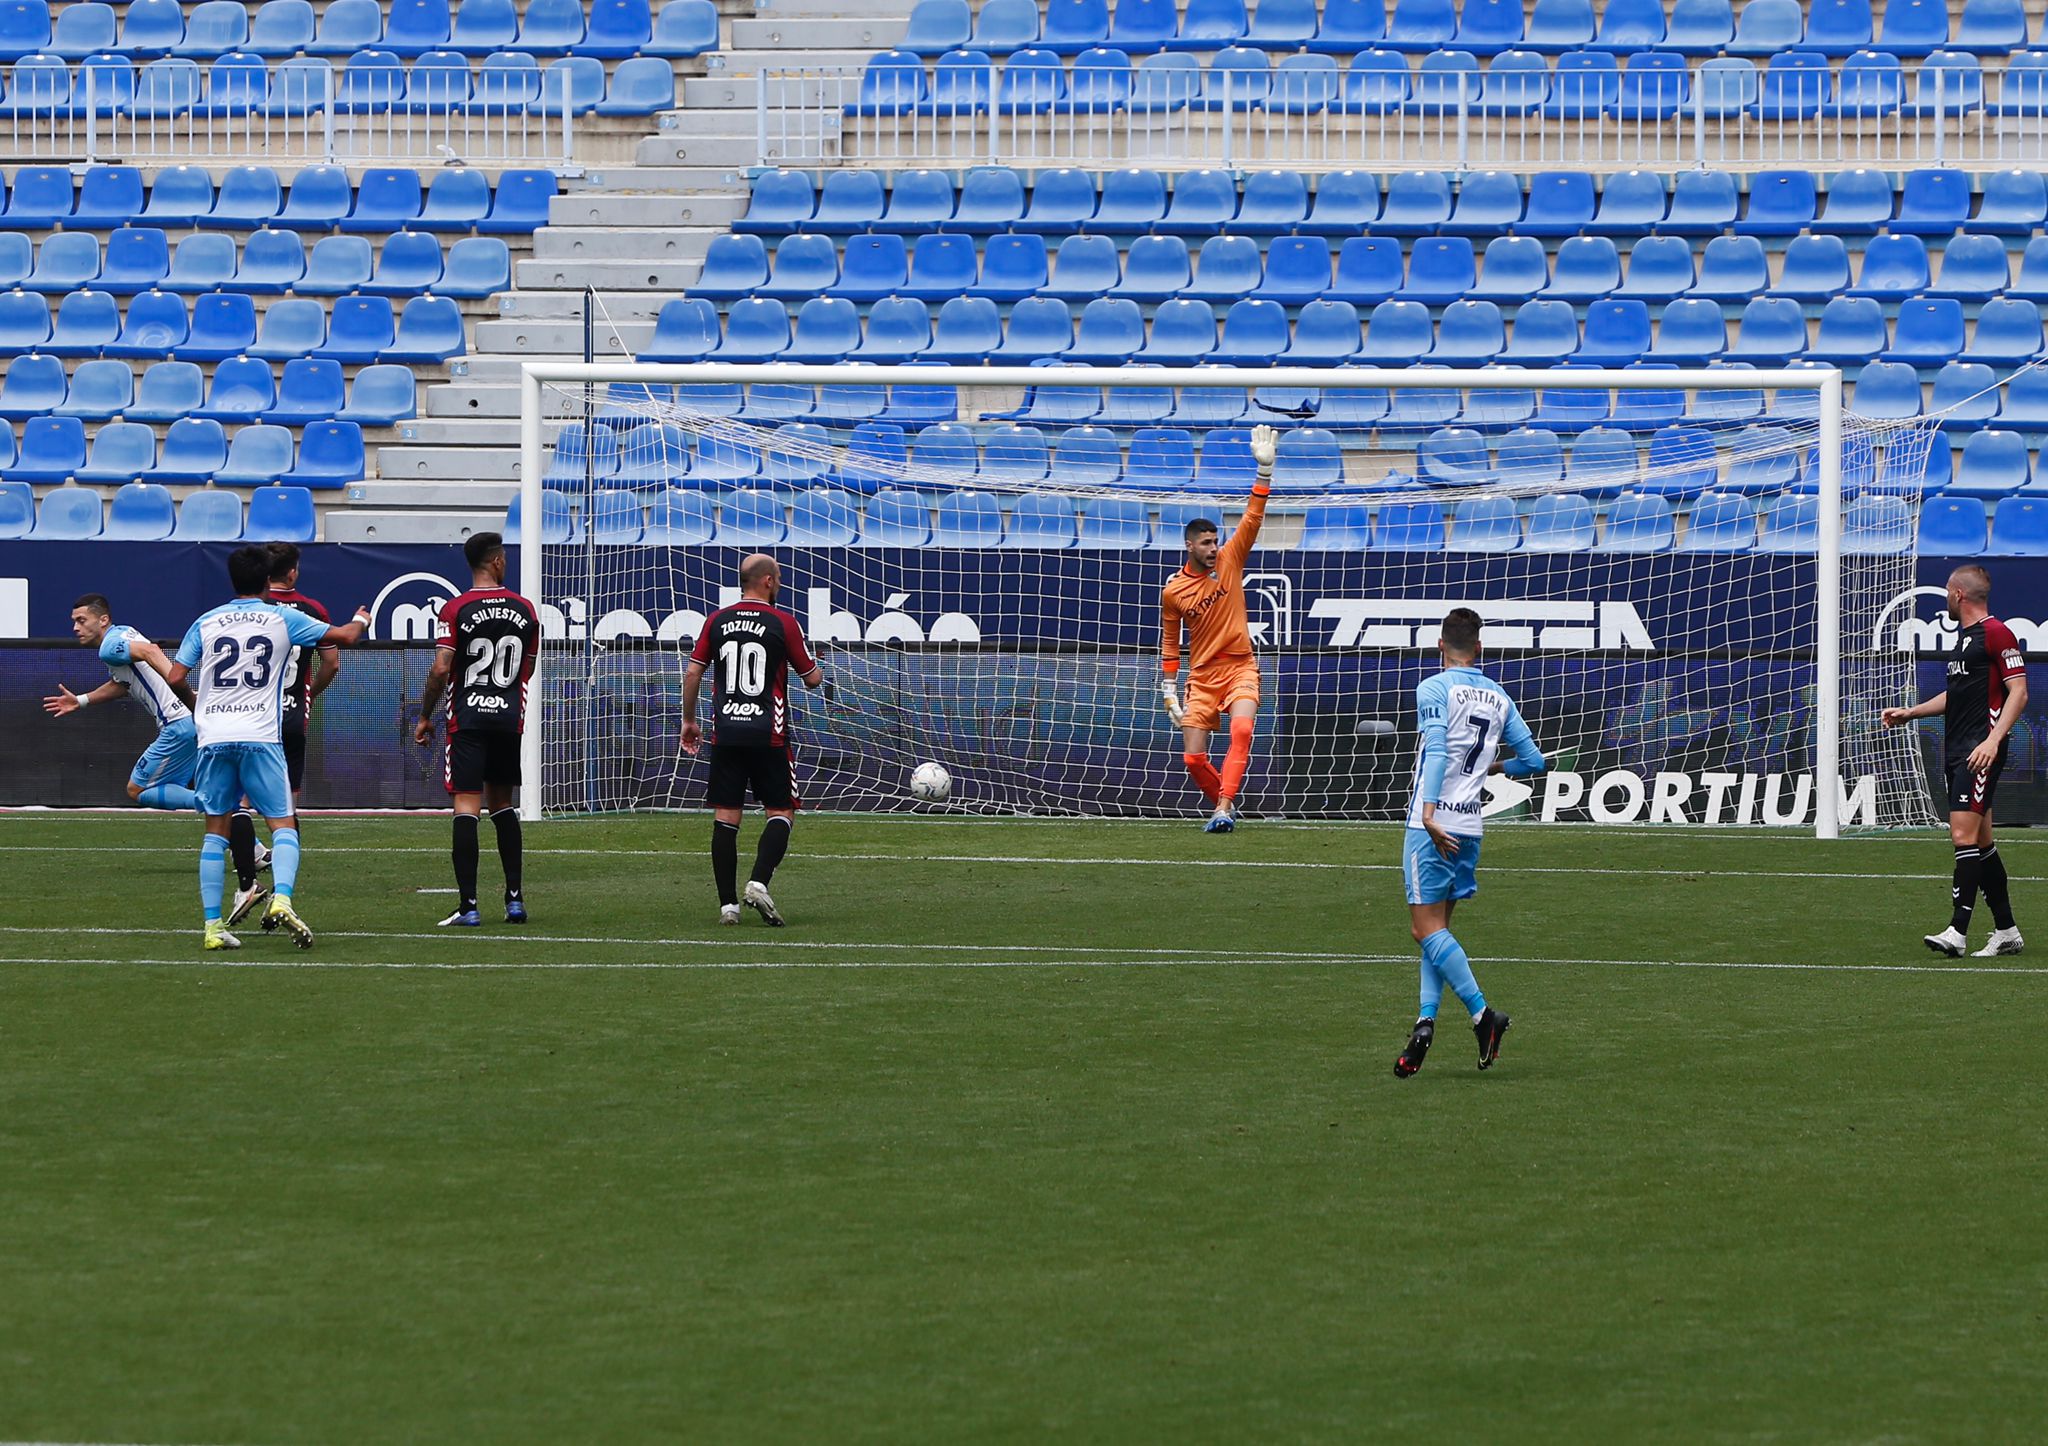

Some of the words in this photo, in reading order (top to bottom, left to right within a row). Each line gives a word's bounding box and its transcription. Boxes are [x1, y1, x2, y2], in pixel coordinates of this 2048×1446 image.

[217, 612, 270, 627] ESCASSI
[460, 622, 475, 634] E.
[471, 607, 528, 630] SILVESTRE
[720, 620, 767, 638] ZOZULIA
[212, 634, 273, 690] 23
[464, 634, 523, 688] 20
[719, 640, 767, 697] 10
[205, 702, 266, 715] BENAHAVIS
[1456, 689, 1503, 713] CRISTIAN
[1460, 713, 1491, 777] 7
